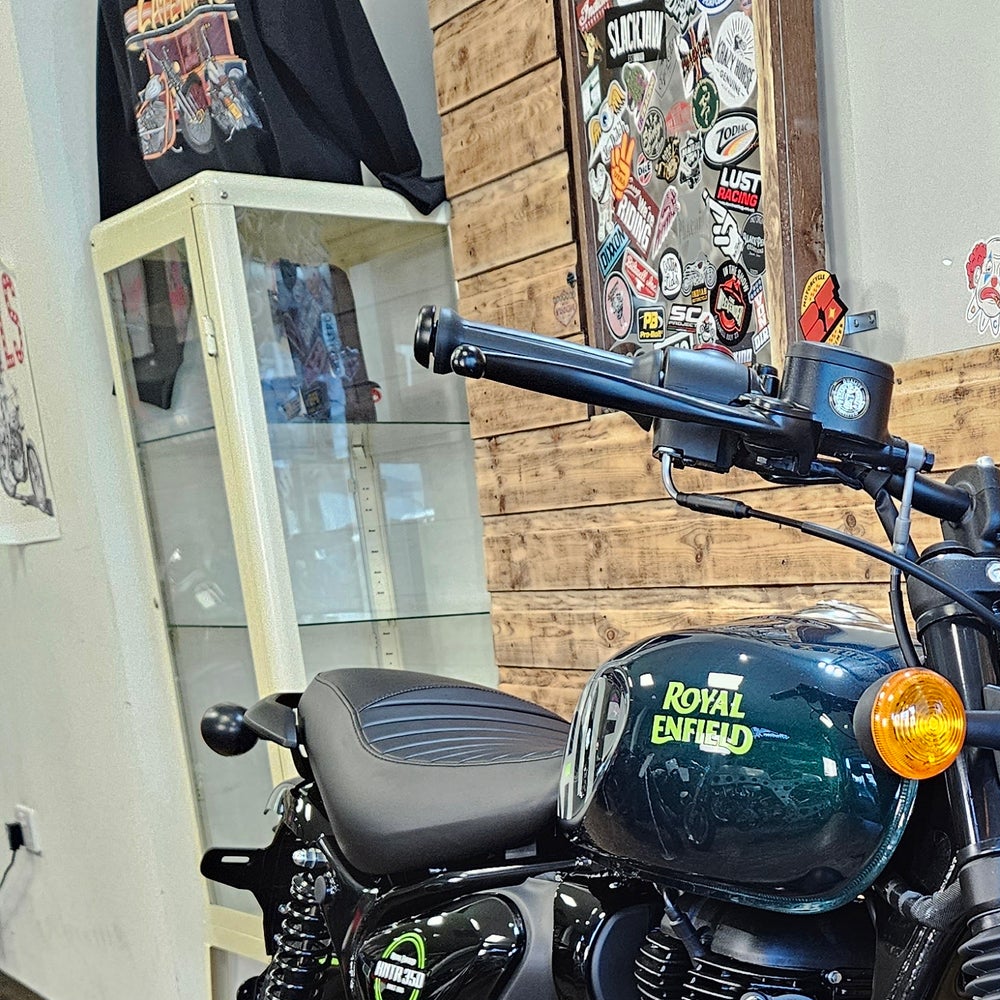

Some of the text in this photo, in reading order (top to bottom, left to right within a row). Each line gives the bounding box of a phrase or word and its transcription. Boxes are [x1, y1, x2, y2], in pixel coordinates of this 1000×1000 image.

[607, 10, 664, 59] SLACKJAW
[716, 122, 749, 155] ZODIAC
[717, 186, 758, 208] RACING
[720, 166, 762, 194] LUST
[617, 194, 652, 254] RIDING
[803, 273, 825, 308] MOTORCYCLE
[643, 311, 659, 330] PB
[662, 681, 746, 719] ROYAL
[650, 715, 753, 755] ENFIELD
